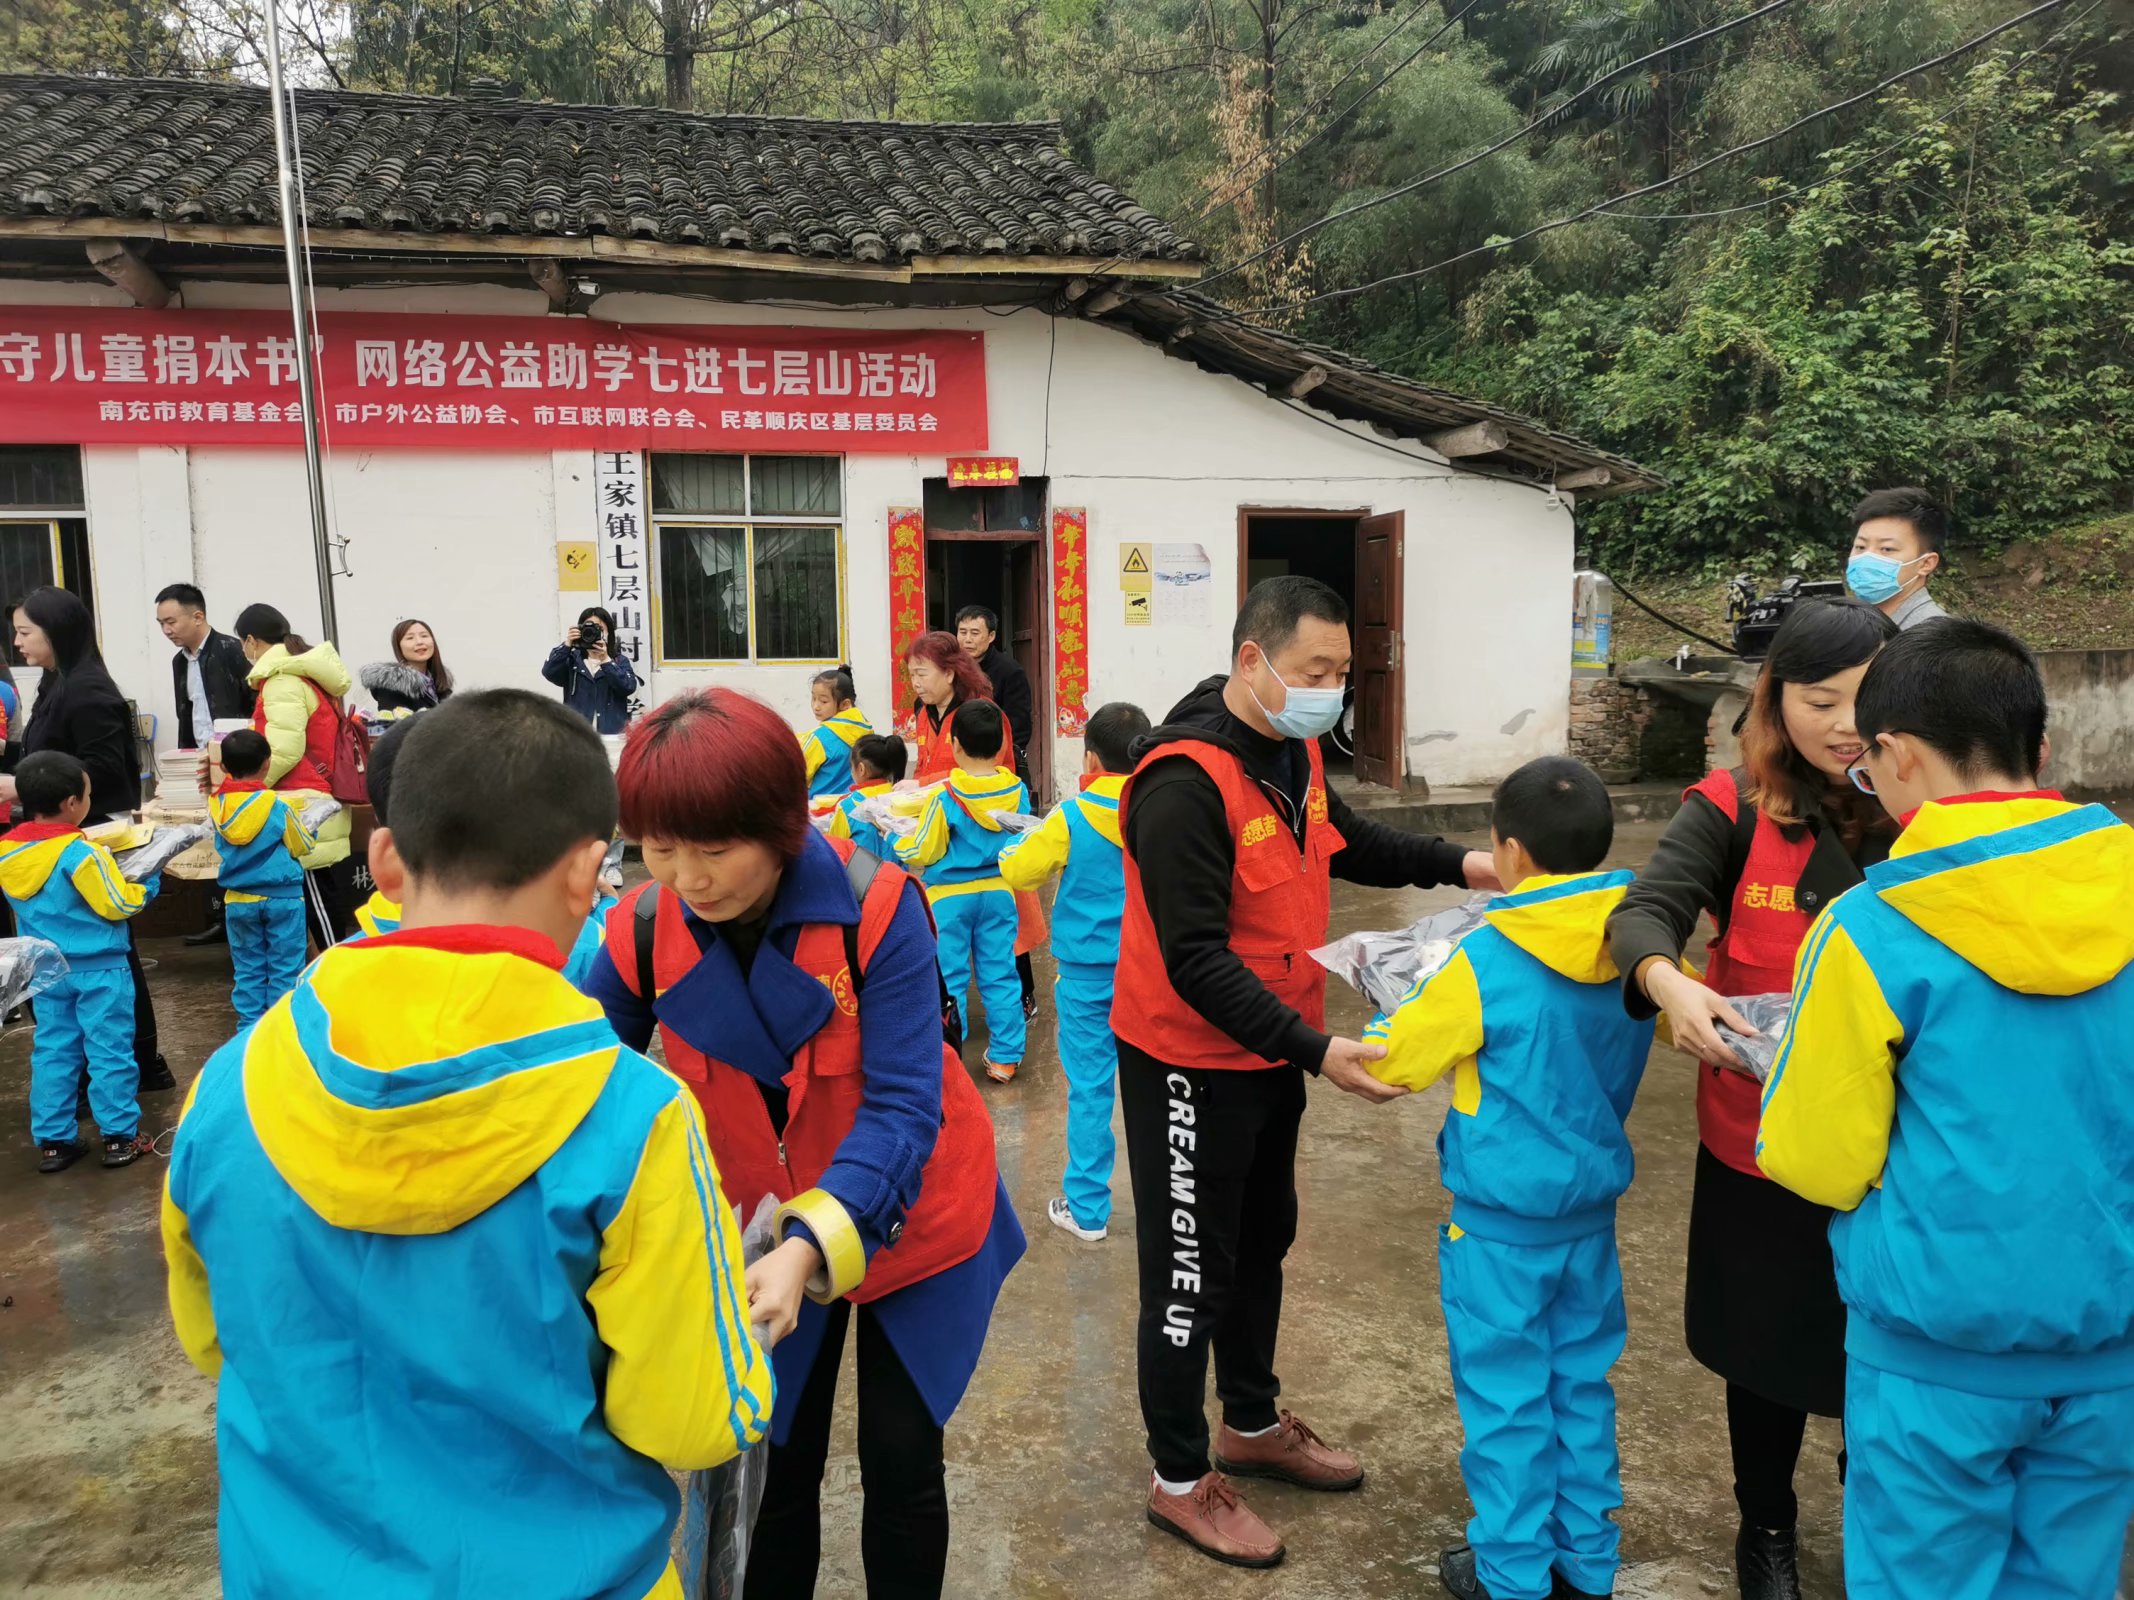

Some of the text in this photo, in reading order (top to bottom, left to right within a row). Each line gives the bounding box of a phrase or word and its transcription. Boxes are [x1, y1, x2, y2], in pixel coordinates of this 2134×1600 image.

[356, 339, 936, 399] 网络公益助学七进七层山活动
[99, 400, 938, 433] 南充市教育基金会市户外公益协会、市互联网联合会、民革顺庆区基层委员会
[1743, 882, 1797, 912] 志愿
[1163, 1073, 1201, 1347] CREAM GIVE UP
